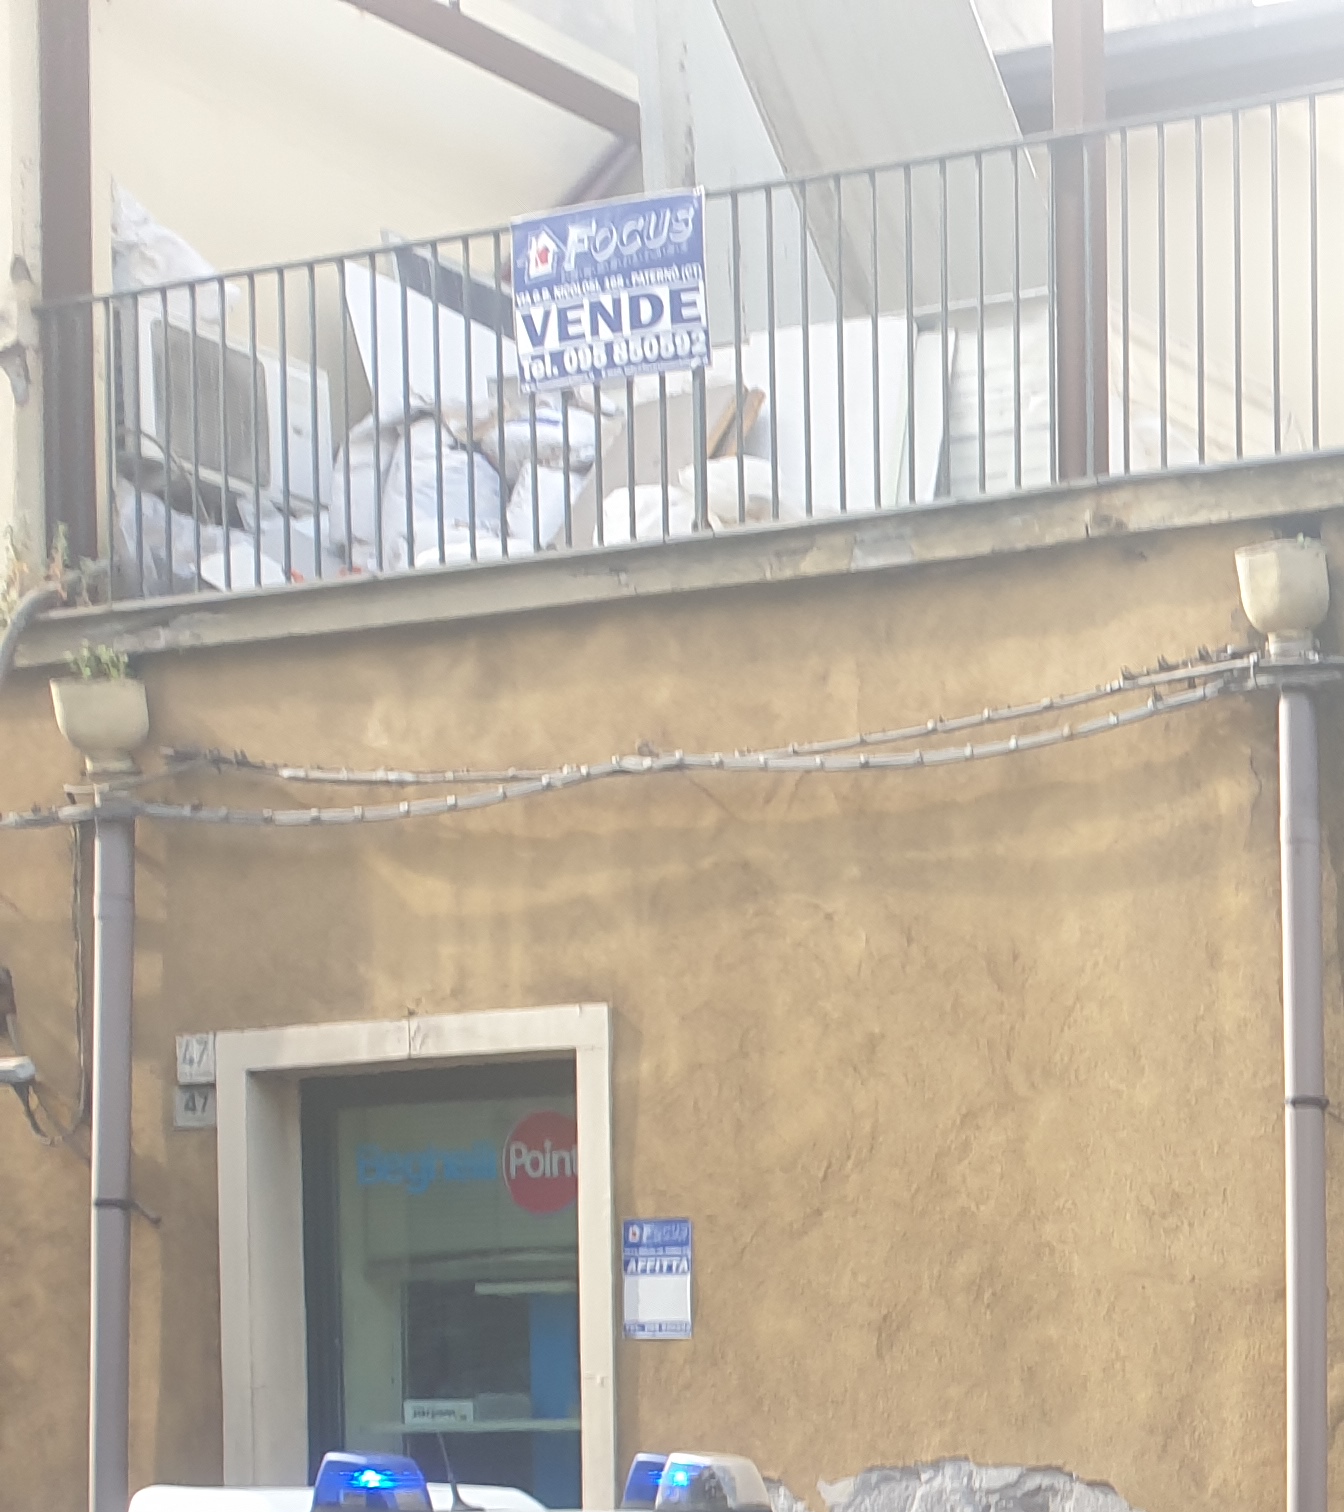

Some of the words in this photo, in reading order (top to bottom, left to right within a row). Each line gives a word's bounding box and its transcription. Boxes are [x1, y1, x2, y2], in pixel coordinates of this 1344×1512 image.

[563, 206, 695, 272] FOCUS
[521, 287, 702, 348] VENDE
[520, 350, 559, 382] Tel.
[182, 1038, 208, 1067] 47
[184, 1091, 209, 1114] 47
[626, 1256, 689, 1274] AFFITTA
